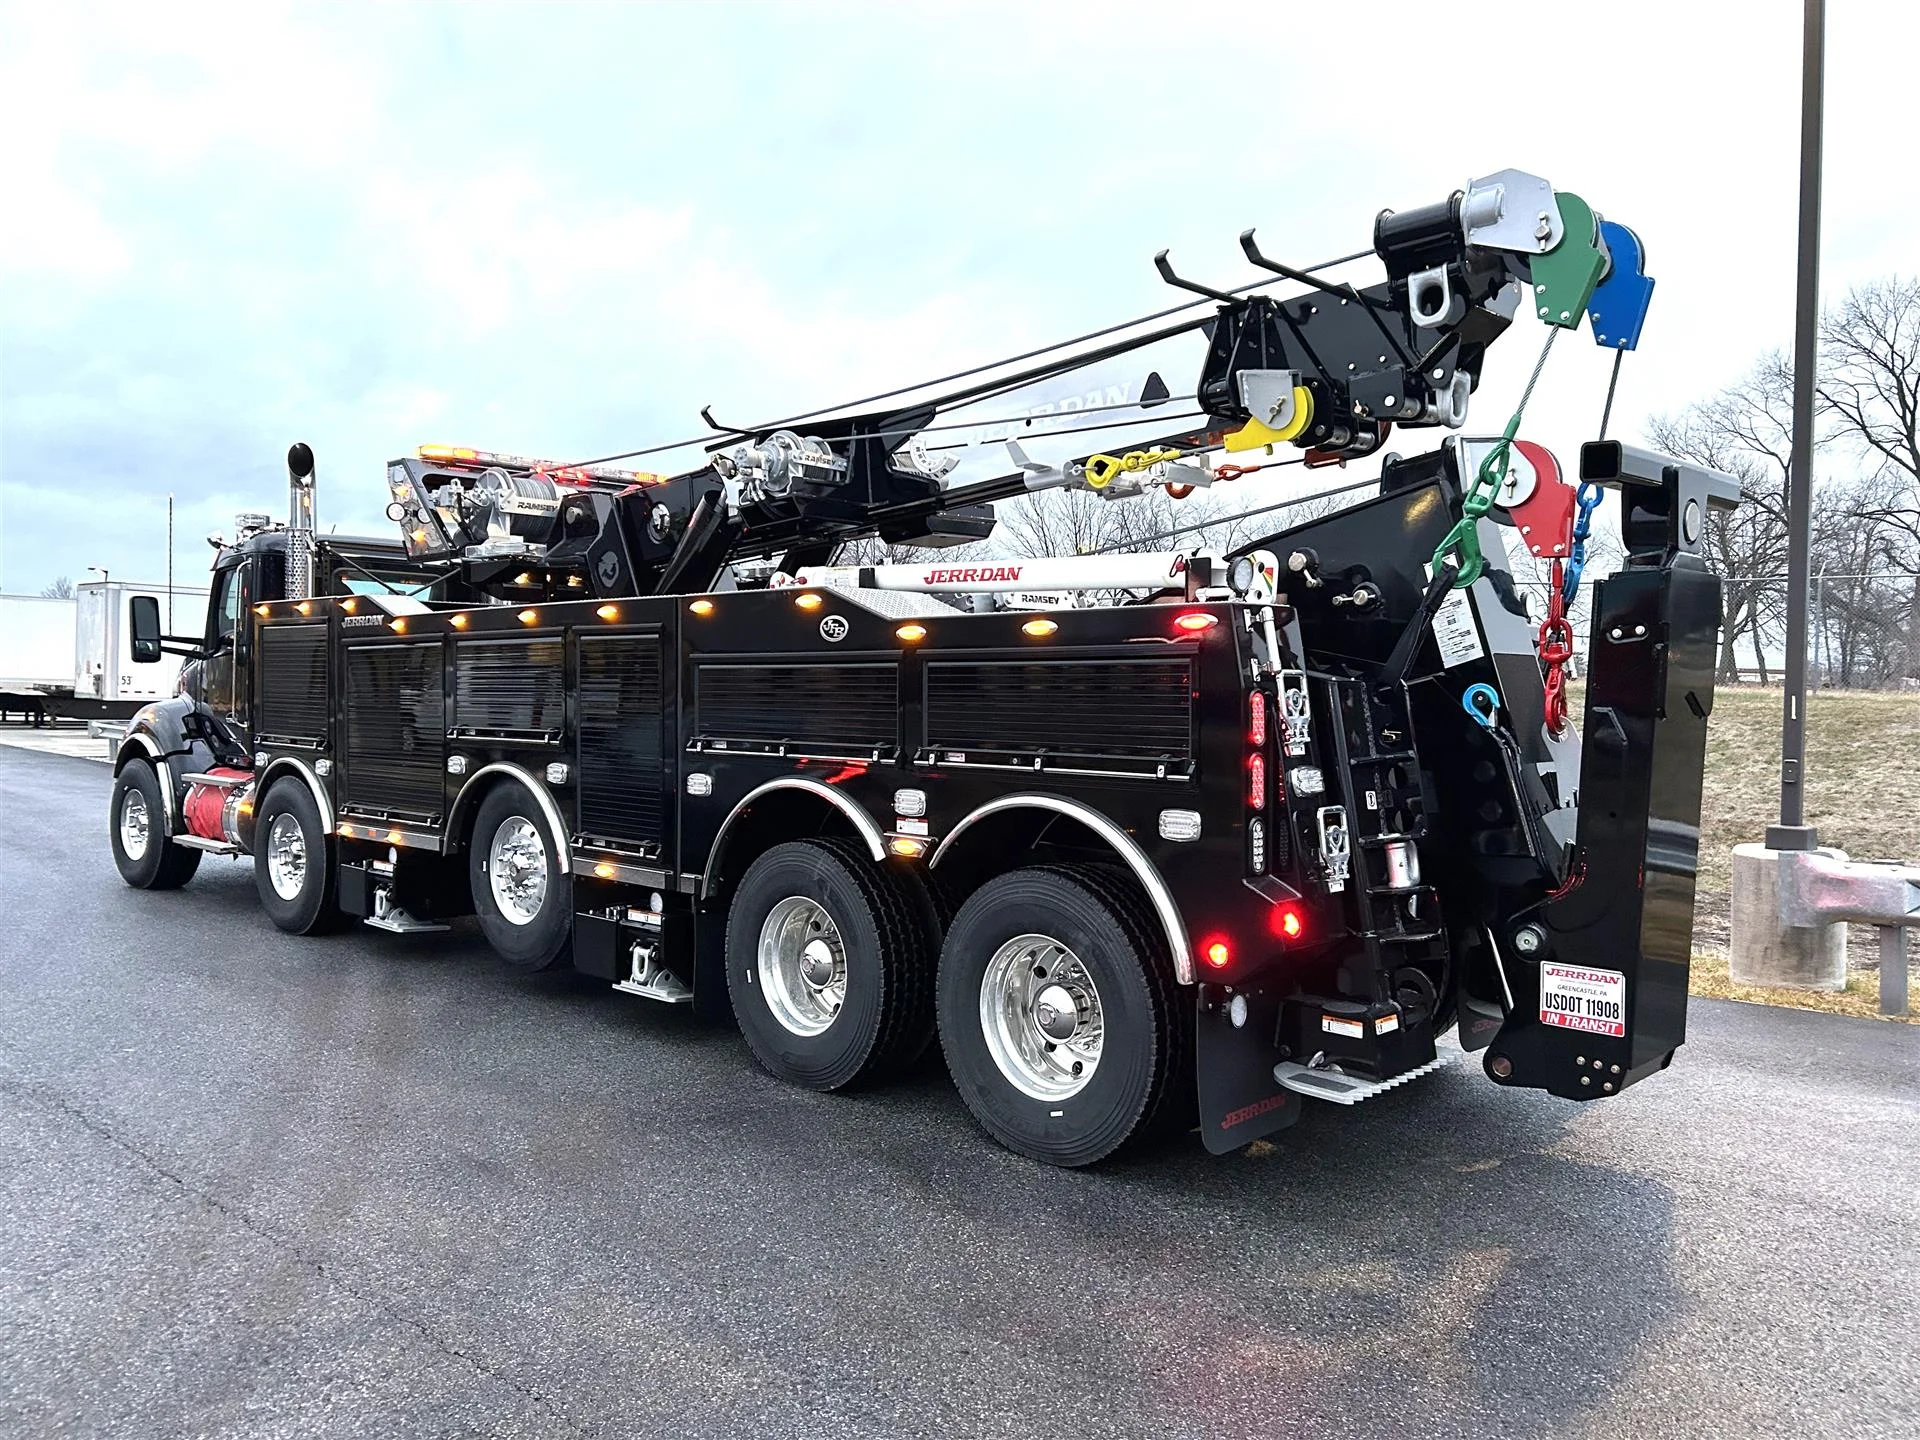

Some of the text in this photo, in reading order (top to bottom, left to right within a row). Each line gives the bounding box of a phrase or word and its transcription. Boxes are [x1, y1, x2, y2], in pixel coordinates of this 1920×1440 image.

[517, 501, 558, 512] RAMSEY
[1021, 594, 1060, 605] RAMSEY
[1546, 992, 1619, 1019] USDOT 11908
[1545, 1012, 1619, 1034] IN TRANSIT
